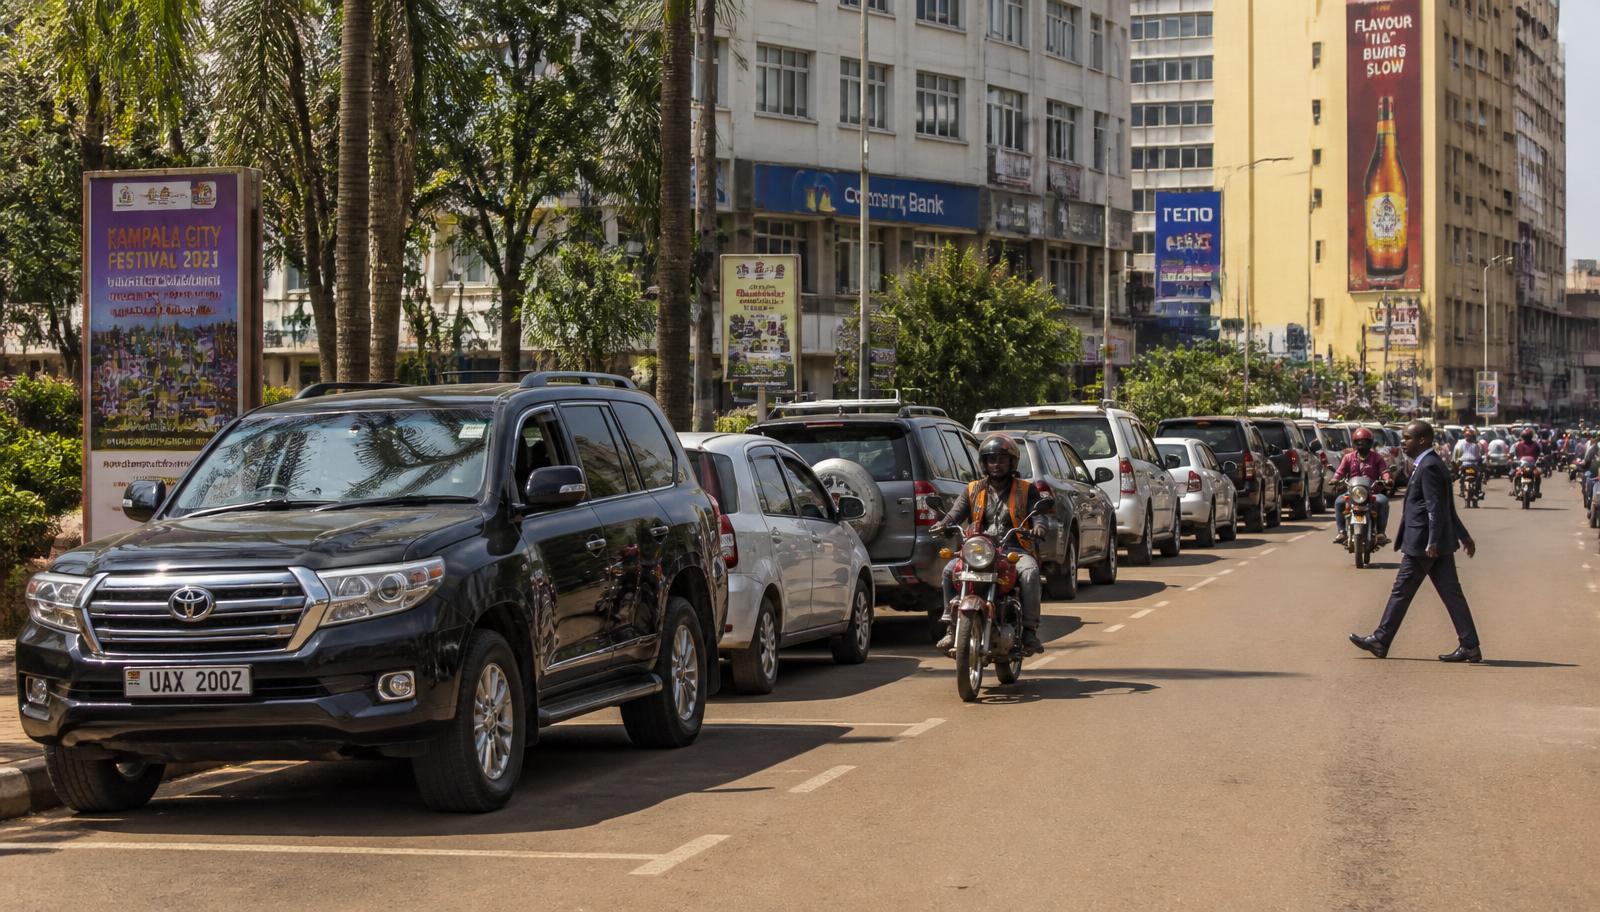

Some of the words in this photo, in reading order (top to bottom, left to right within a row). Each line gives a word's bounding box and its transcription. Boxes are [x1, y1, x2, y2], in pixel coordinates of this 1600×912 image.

[1354, 15, 1412, 33] FLAVOUR
[1366, 59, 1404, 77] SLOW
[909, 192, 945, 216] Bank
[108, 225, 181, 250] KAMPALA
[185, 224, 222, 249] CITY
[108, 251, 177, 271] FESTIVAL
[149, 671, 185, 692] UAX
[196, 671, 242, 691] 200Z
